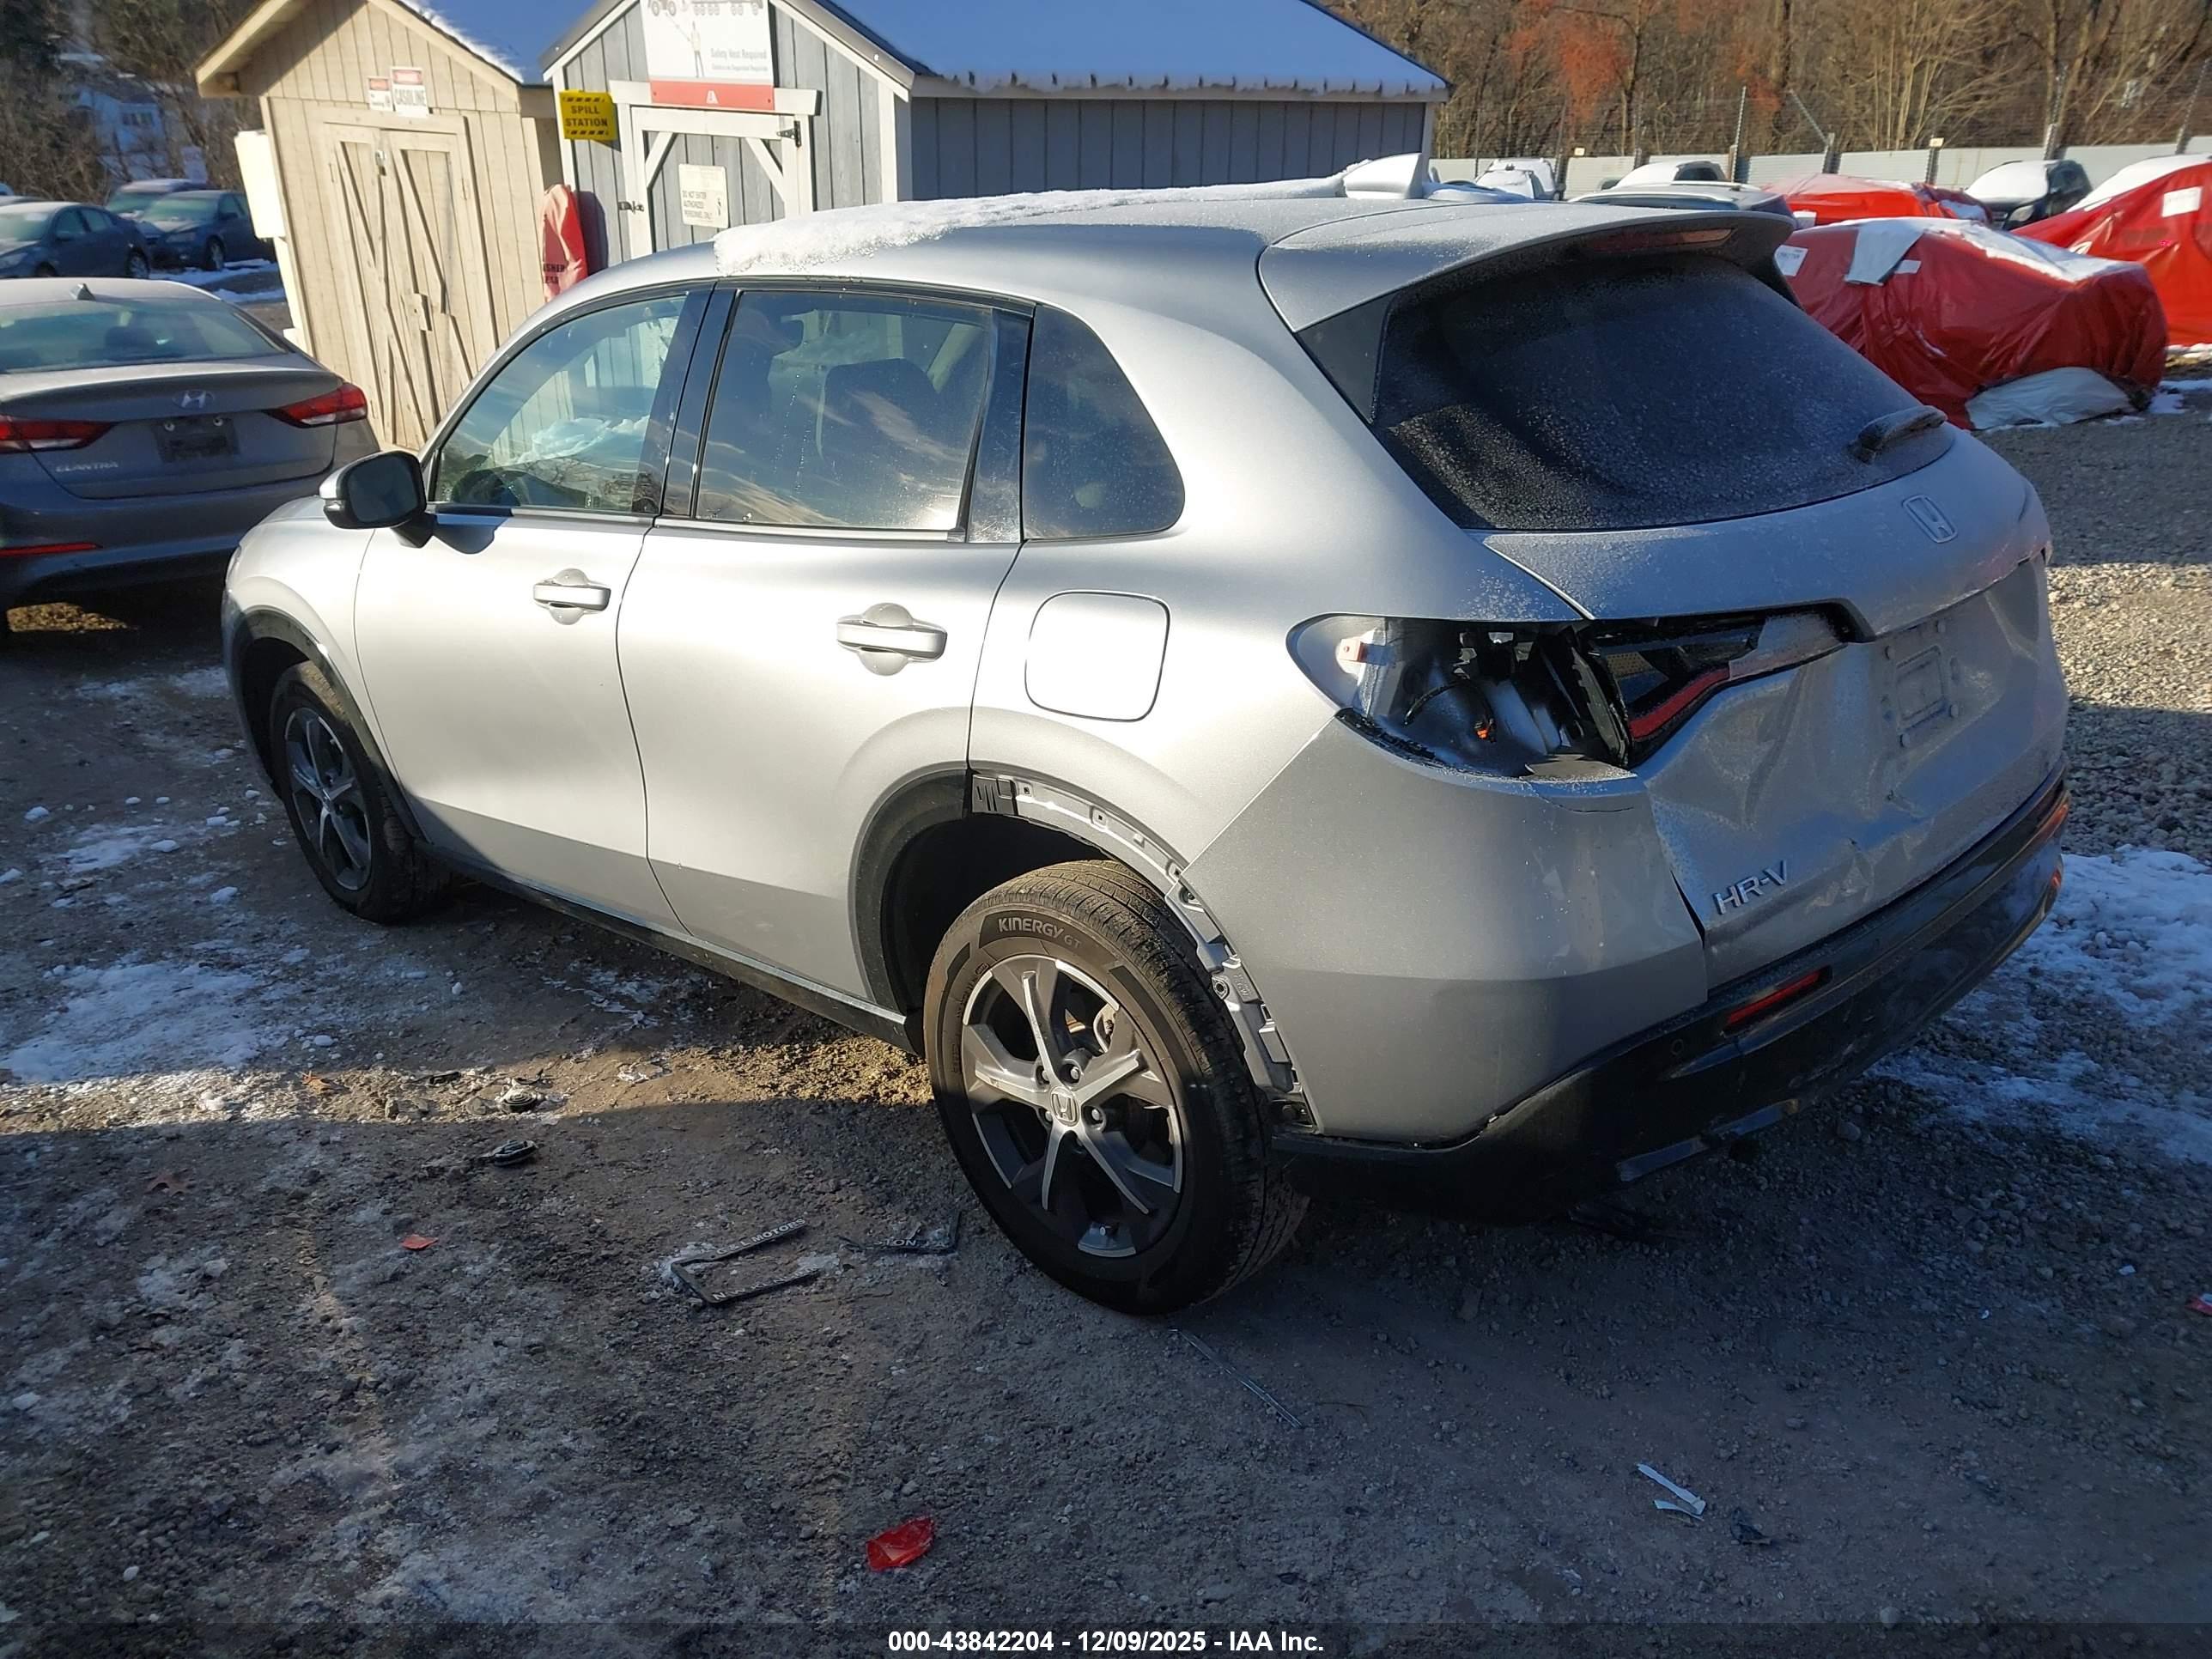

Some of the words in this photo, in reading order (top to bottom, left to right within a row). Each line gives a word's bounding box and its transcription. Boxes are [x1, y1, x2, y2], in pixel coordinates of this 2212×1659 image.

[394, 88, 427, 106] GASOLINE
[571, 105, 600, 114] SPILL
[565, 118, 608, 127] STATION
[1712, 860, 1787, 915] HR-V
[998, 916, 1065, 939] KINERGY
[1064, 934, 1082, 949] GT
[715, 1247, 727, 1255] G
[740, 1238, 750, 1247] L
[750, 1218, 806, 1243] MOTORS
